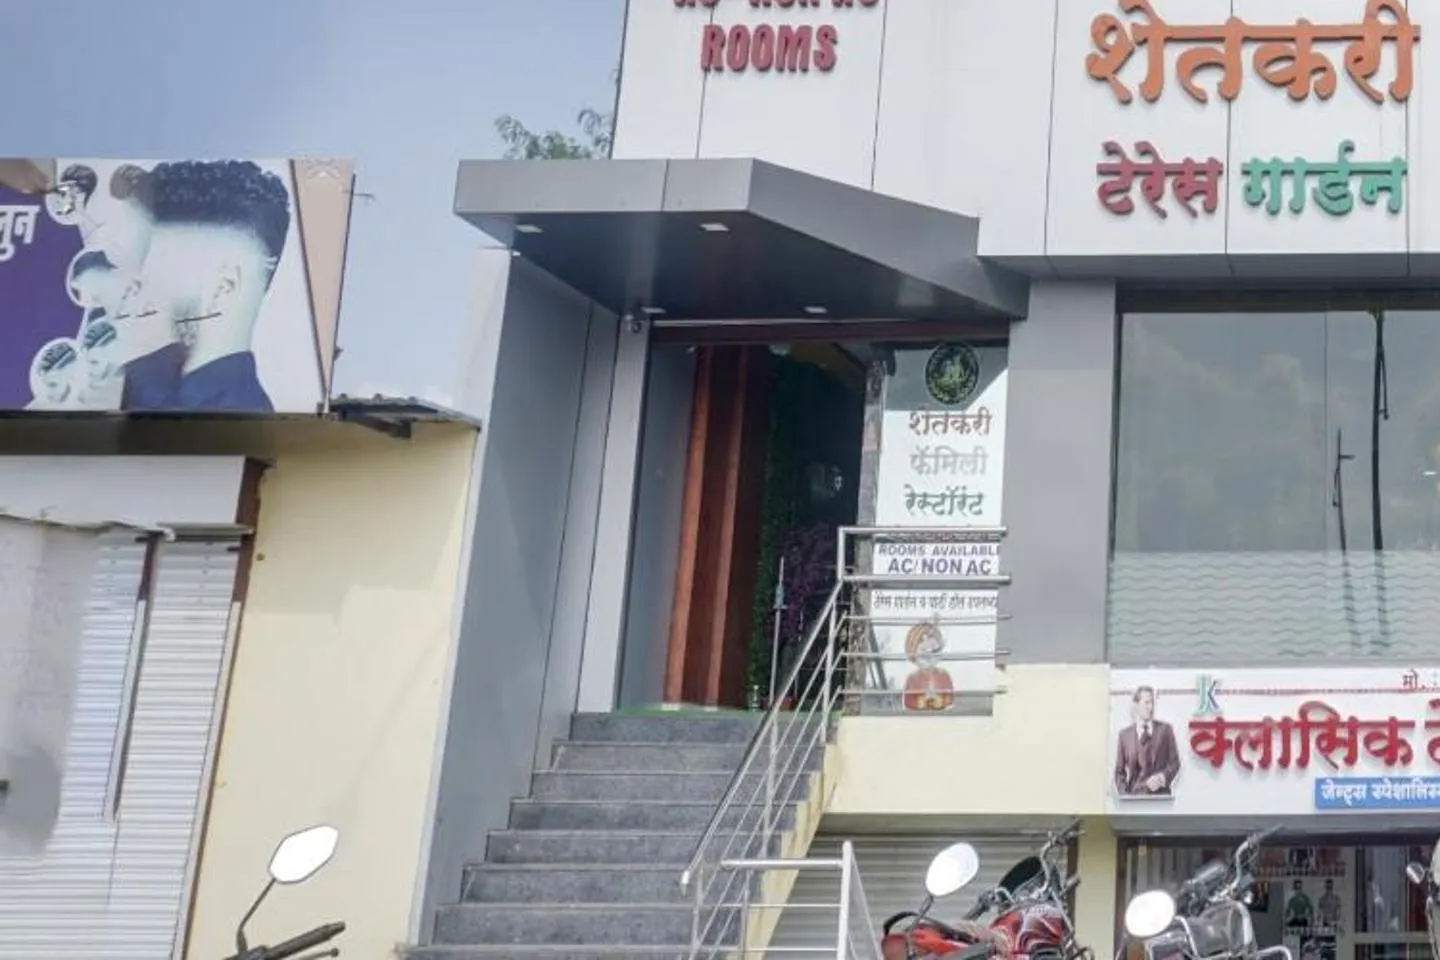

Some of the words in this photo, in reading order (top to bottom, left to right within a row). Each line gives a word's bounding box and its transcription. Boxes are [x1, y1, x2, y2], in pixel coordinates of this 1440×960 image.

[700, 23, 839, 73] ROOMS
[1096, 139, 1224, 220] टेरेस
[1241, 139, 1408, 217] गार्डन
[878, 544, 926, 556] ROOMS
[965, 560, 992, 576] AC
[1188, 701, 1415, 770] क्लासिक
